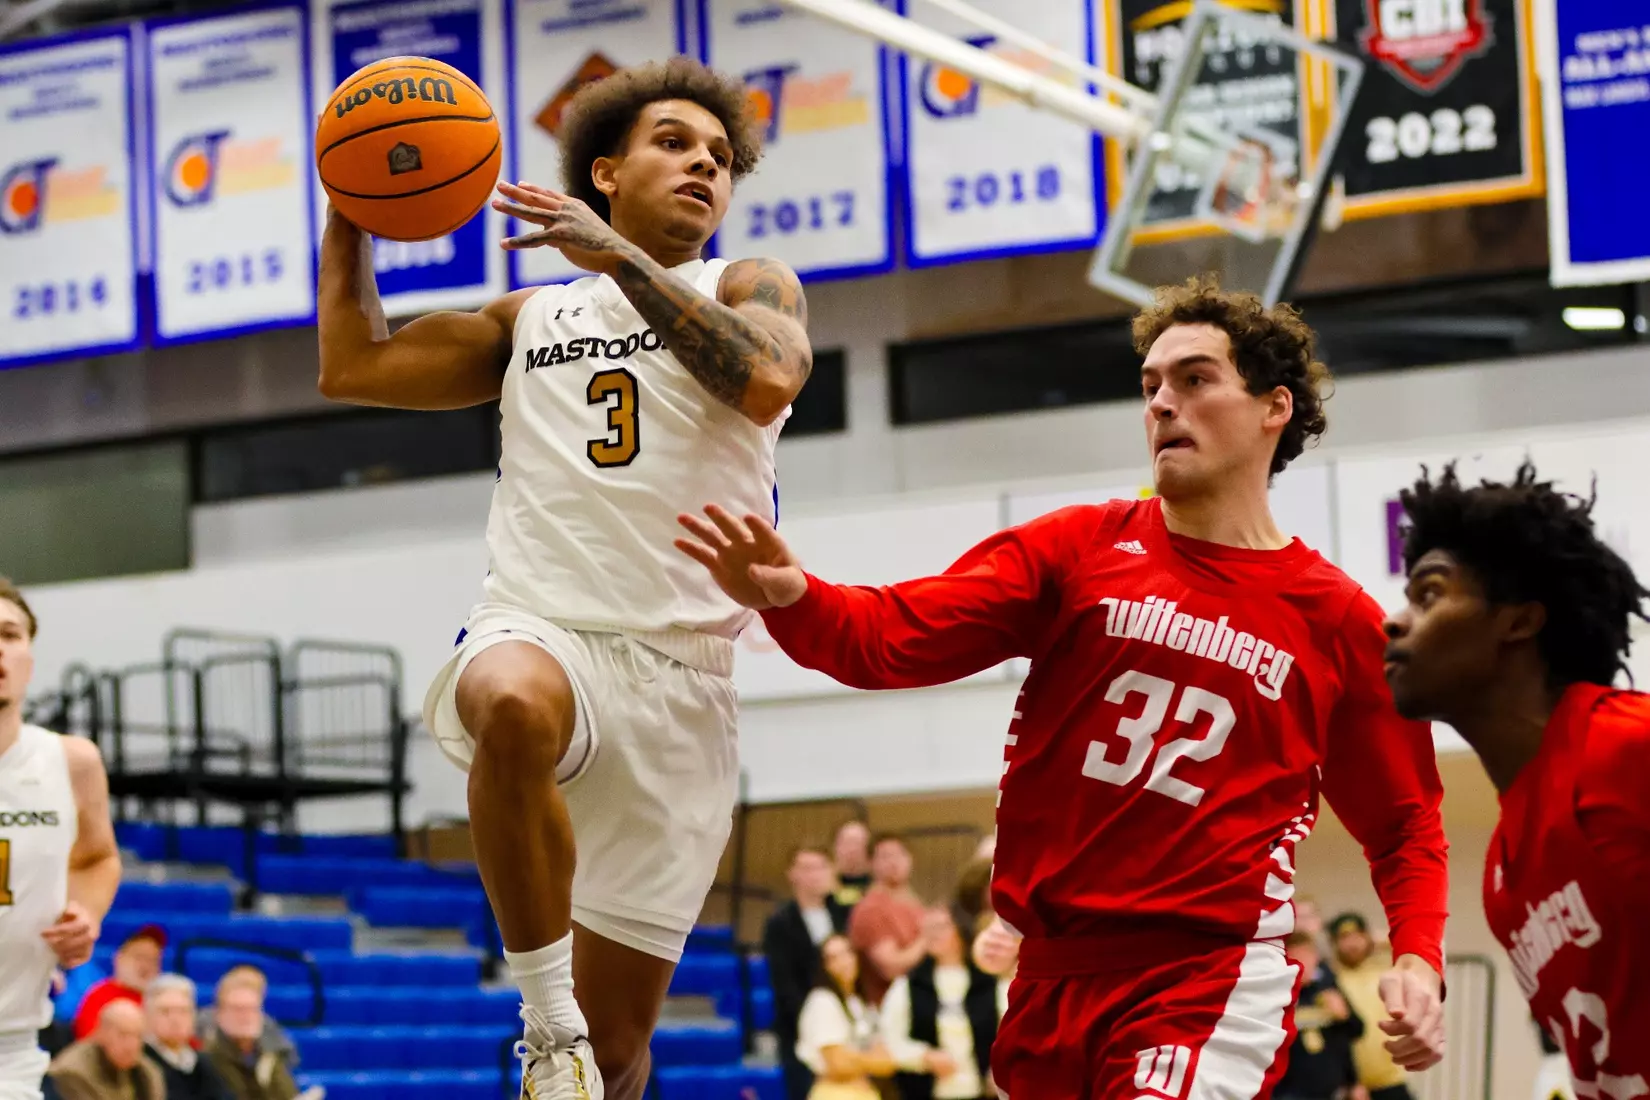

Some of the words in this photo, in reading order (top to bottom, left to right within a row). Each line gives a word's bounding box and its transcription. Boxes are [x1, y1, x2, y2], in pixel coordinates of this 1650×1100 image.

[335, 77, 458, 119] Wilson
[1365, 104, 1498, 164] 2022
[946, 166, 1060, 211] 2018
[747, 191, 855, 237] 2017
[187, 252, 284, 294] 2015
[525, 328, 667, 373] MASTODO
[586, 367, 640, 468] 3
[1082, 669, 1237, 807] 32
